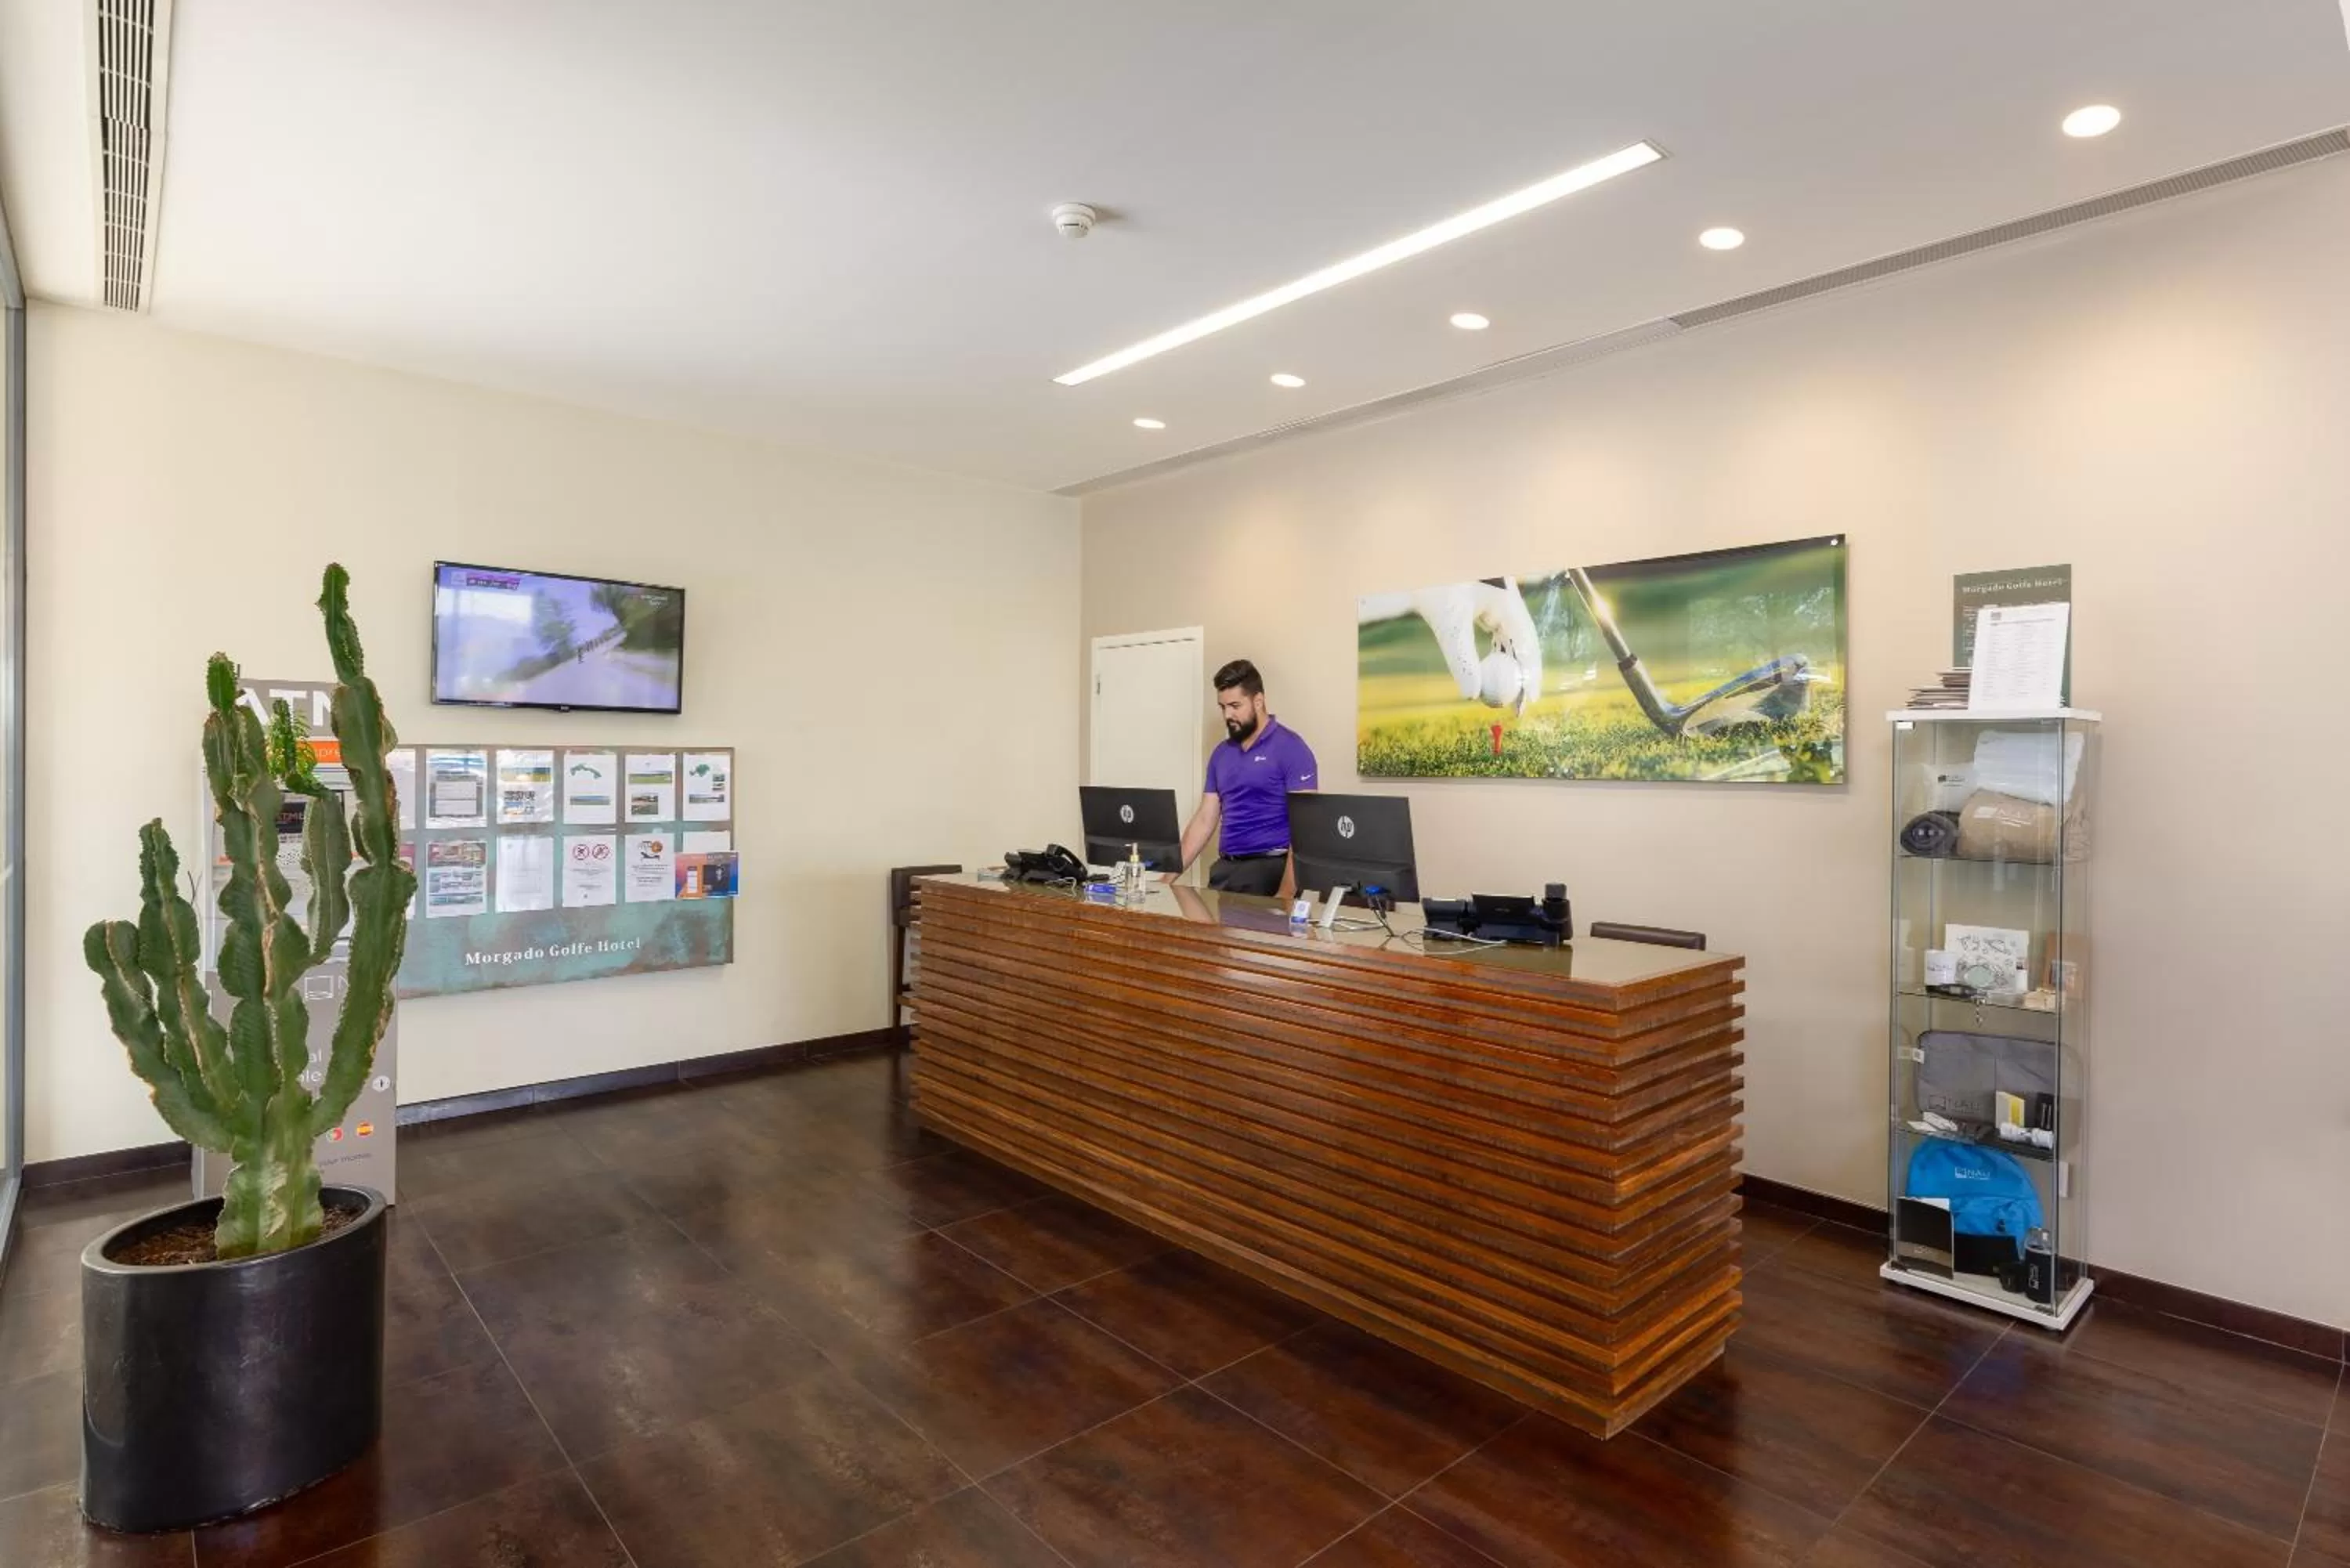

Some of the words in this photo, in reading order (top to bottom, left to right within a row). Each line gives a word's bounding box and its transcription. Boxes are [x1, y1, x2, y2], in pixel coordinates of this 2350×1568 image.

[465, 946, 544, 966] Morgado
[549, 941, 593, 957] Golfe
[597, 937, 641, 952] Hotel
